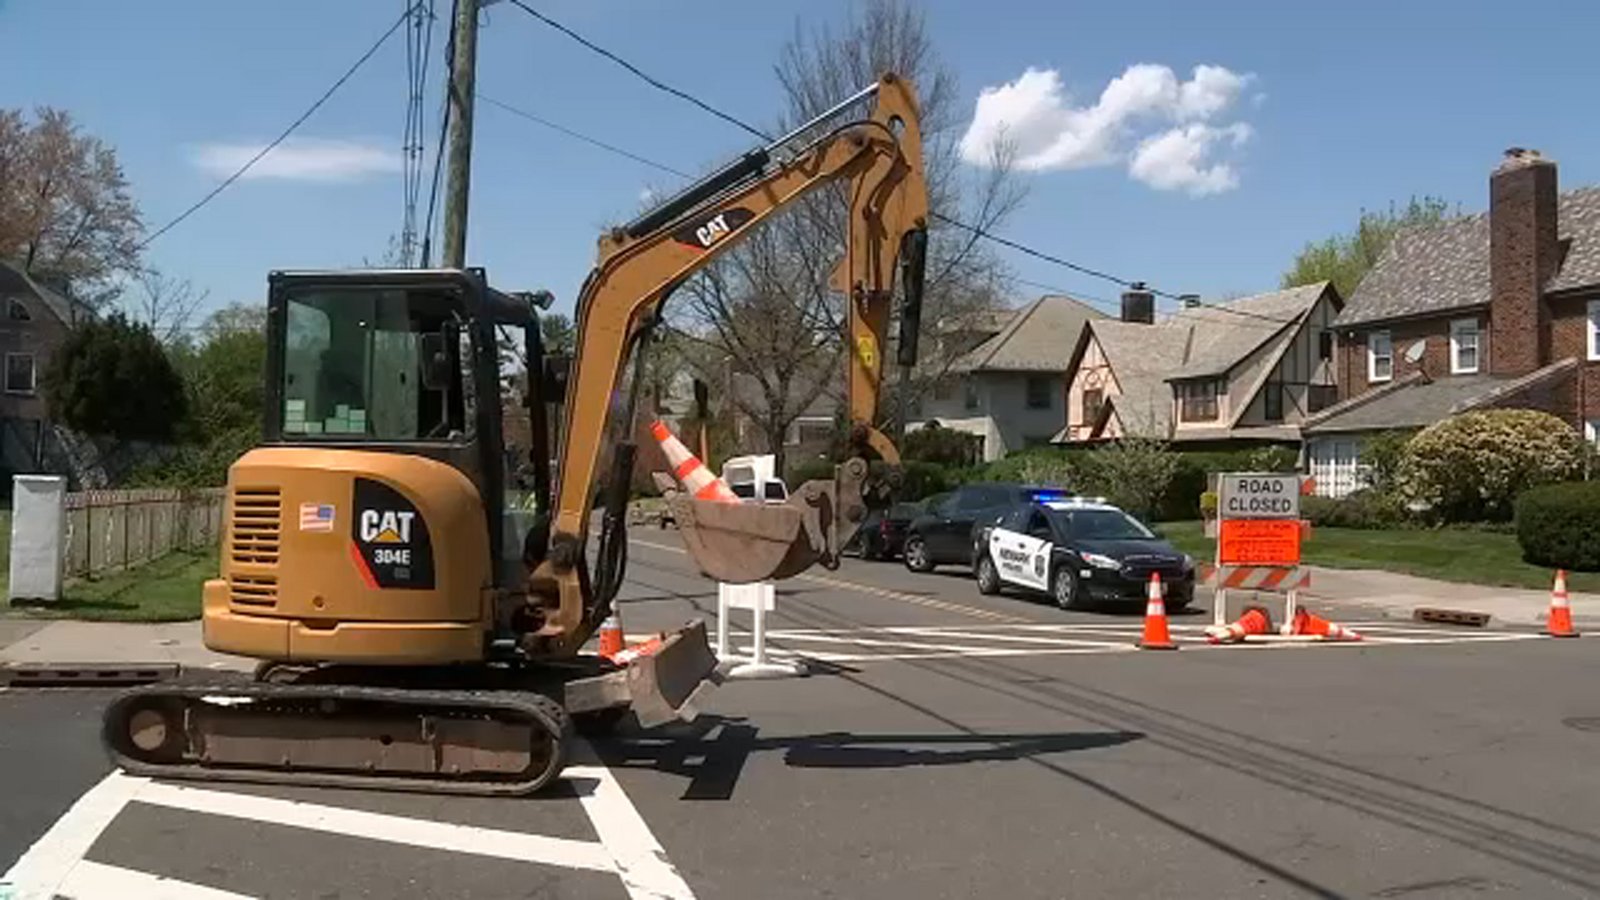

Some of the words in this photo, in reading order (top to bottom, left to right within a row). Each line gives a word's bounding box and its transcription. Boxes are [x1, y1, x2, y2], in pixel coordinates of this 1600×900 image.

[696, 214, 731, 247] CAT
[1237, 479, 1283, 494] ROAD
[1228, 497, 1292, 513] CLOSED
[360, 509, 415, 543] CAT
[374, 549, 411, 565] 304E
